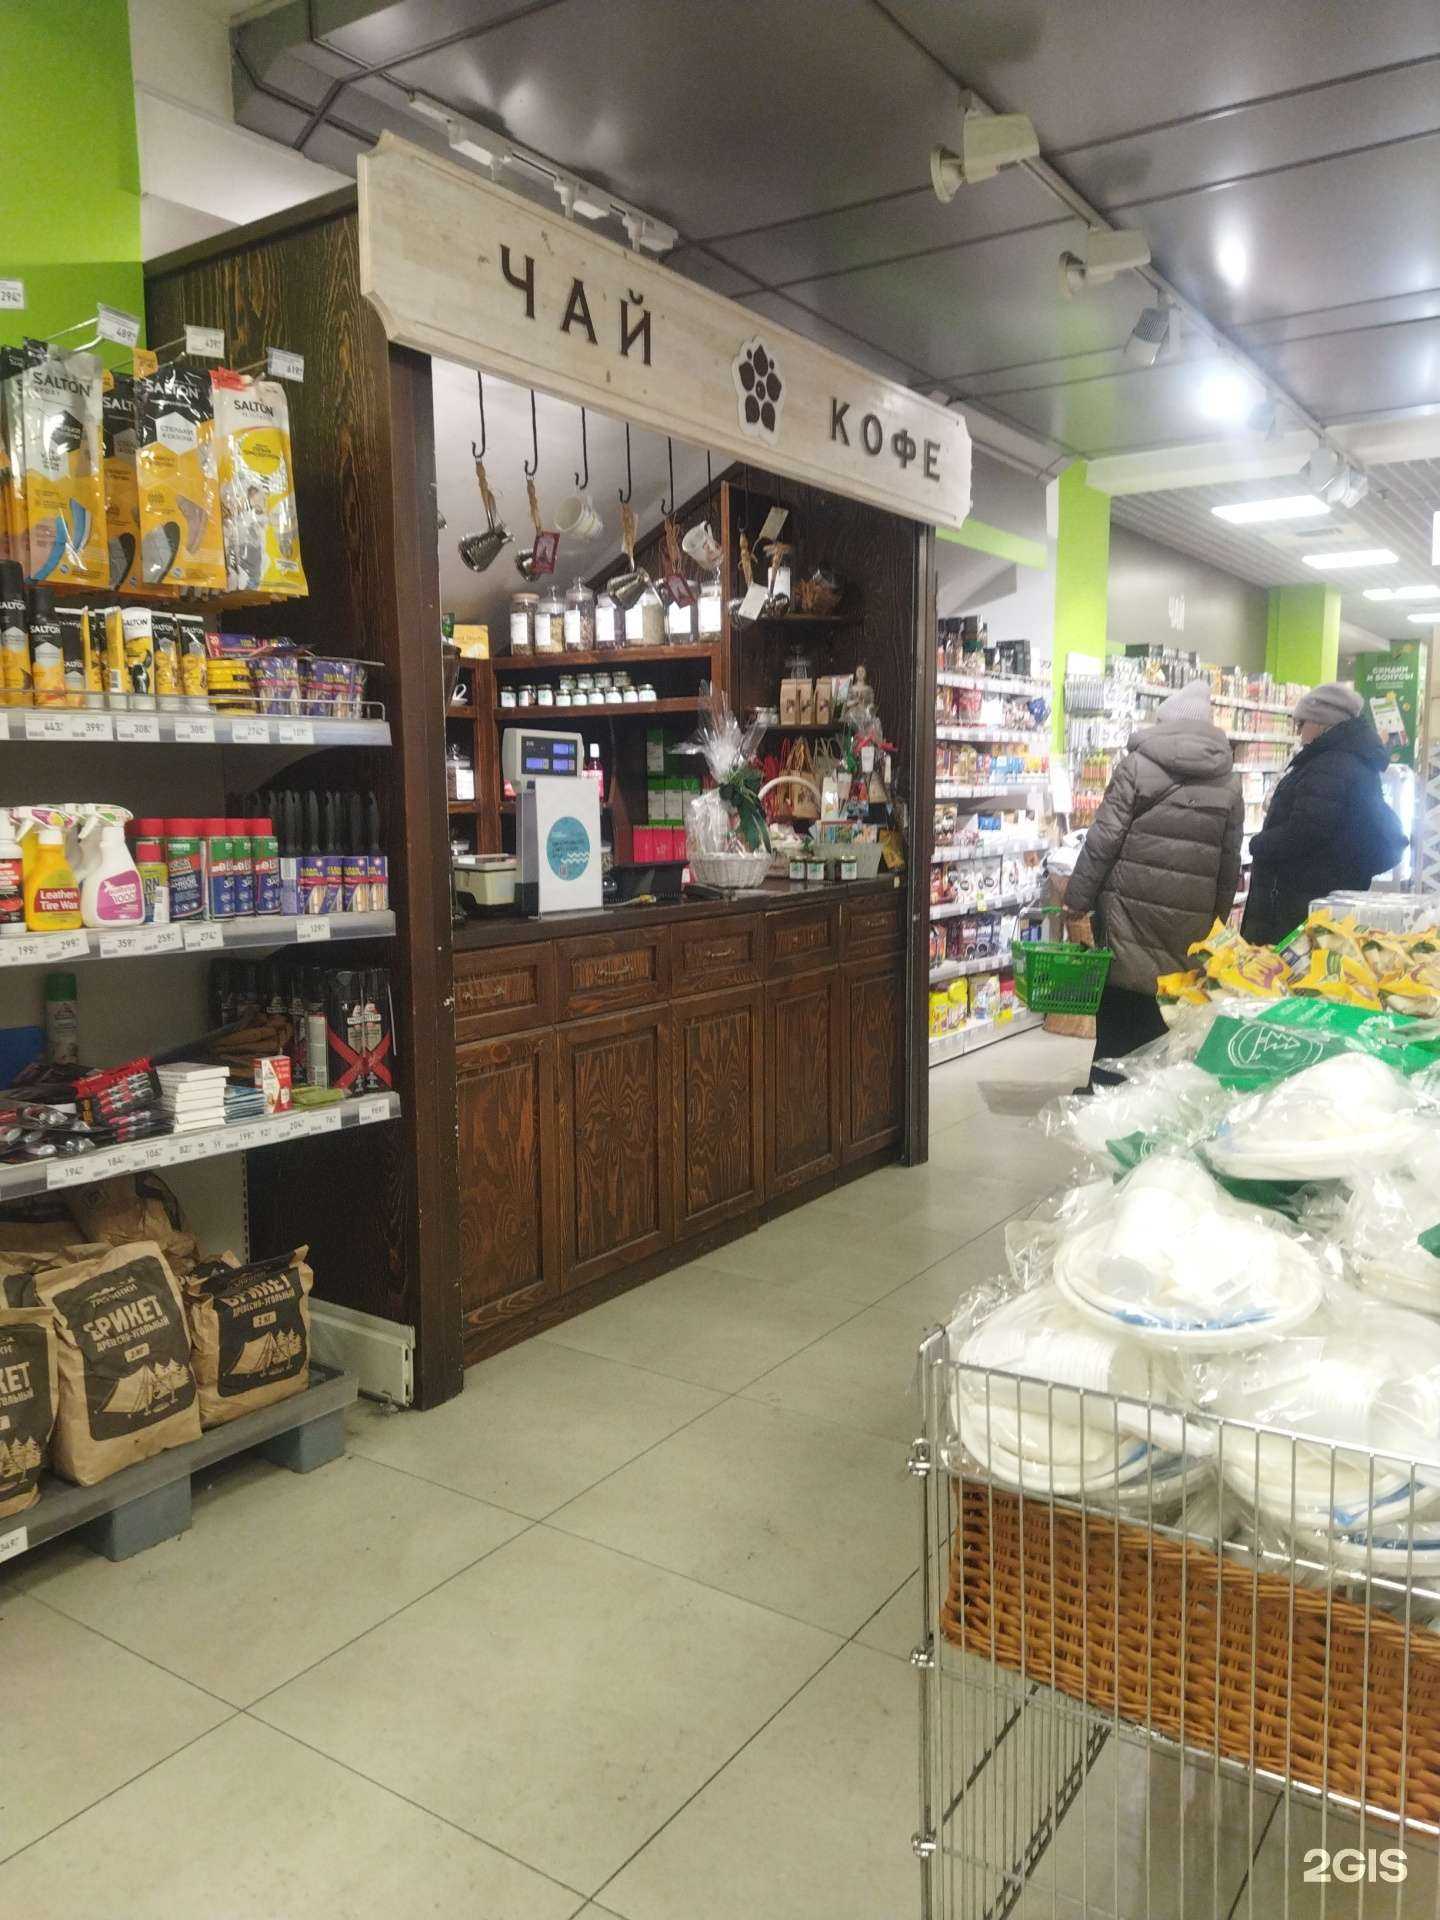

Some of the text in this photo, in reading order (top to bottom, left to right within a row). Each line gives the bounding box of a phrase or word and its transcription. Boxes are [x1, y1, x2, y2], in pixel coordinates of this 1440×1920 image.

[500, 243, 653, 367] ЧАЙ
[33, 371, 91, 397] SALTON
[103, 396, 135, 412] SALT
[233, 400, 274, 417] SALTON
[829, 396, 942, 483] КОФЕ
[82, 1295, 163, 1342] БРИКЕТ
